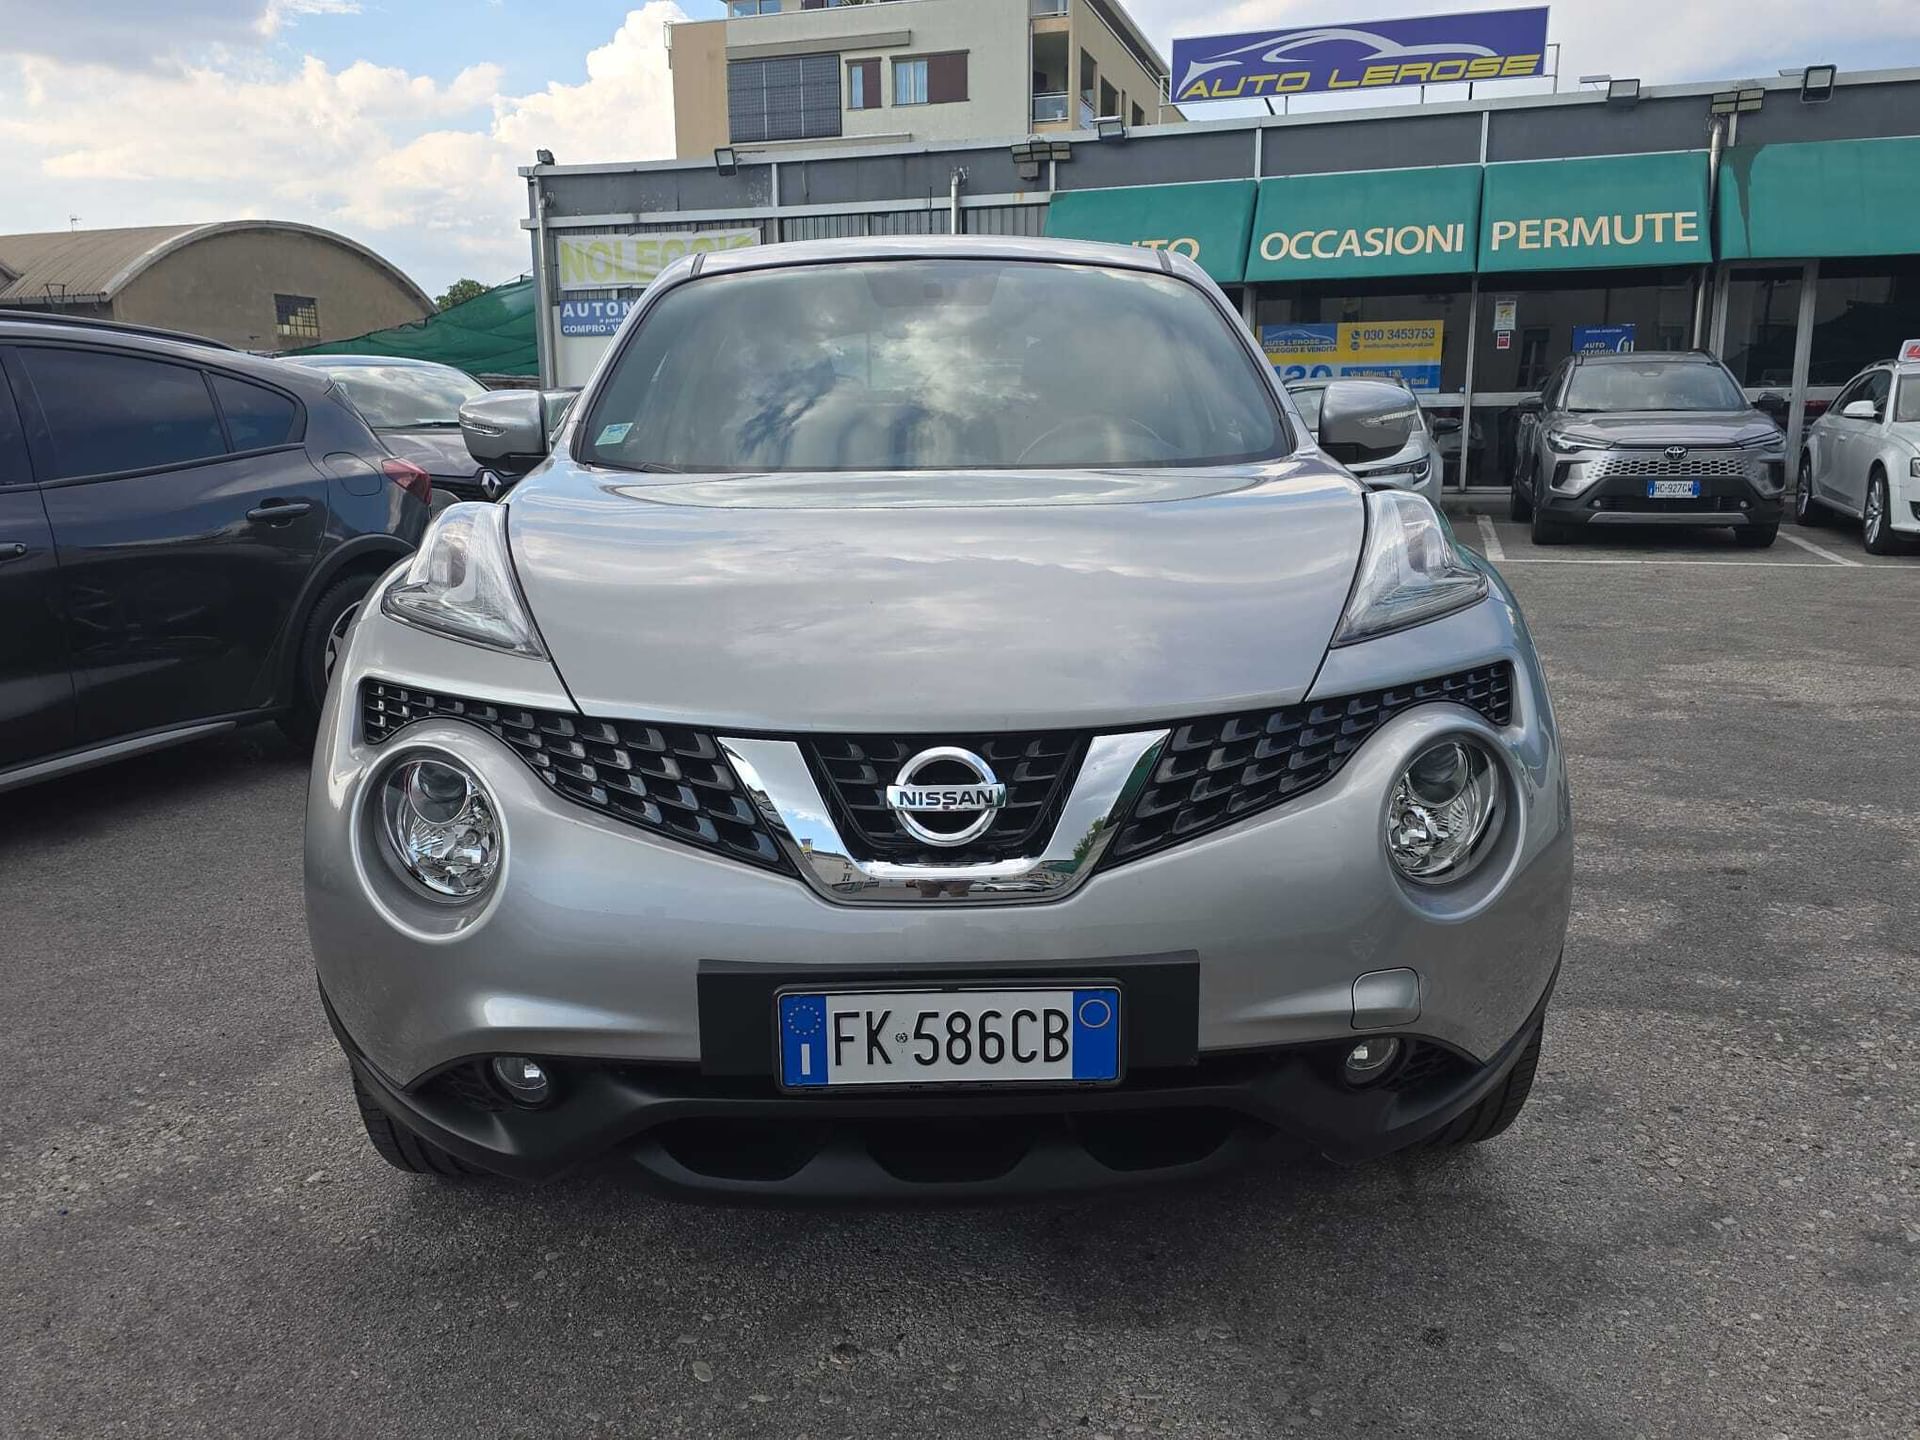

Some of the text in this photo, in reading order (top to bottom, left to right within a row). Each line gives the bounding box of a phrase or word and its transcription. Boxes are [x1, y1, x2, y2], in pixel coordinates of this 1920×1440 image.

[1180, 54, 1541, 100] AUTO LEROSE
[1260, 223, 1464, 261] OCCASIONI
[1491, 211, 1699, 251] PERMUTE
[560, 235, 754, 284] NOLE
[563, 325, 606, 333] COMPRO
[1307, 345, 1337, 353] VENDITA
[899, 790, 993, 806] NISSAN
[832, 1010, 893, 1067] FK
[913, 1008, 1069, 1066] 586CB
